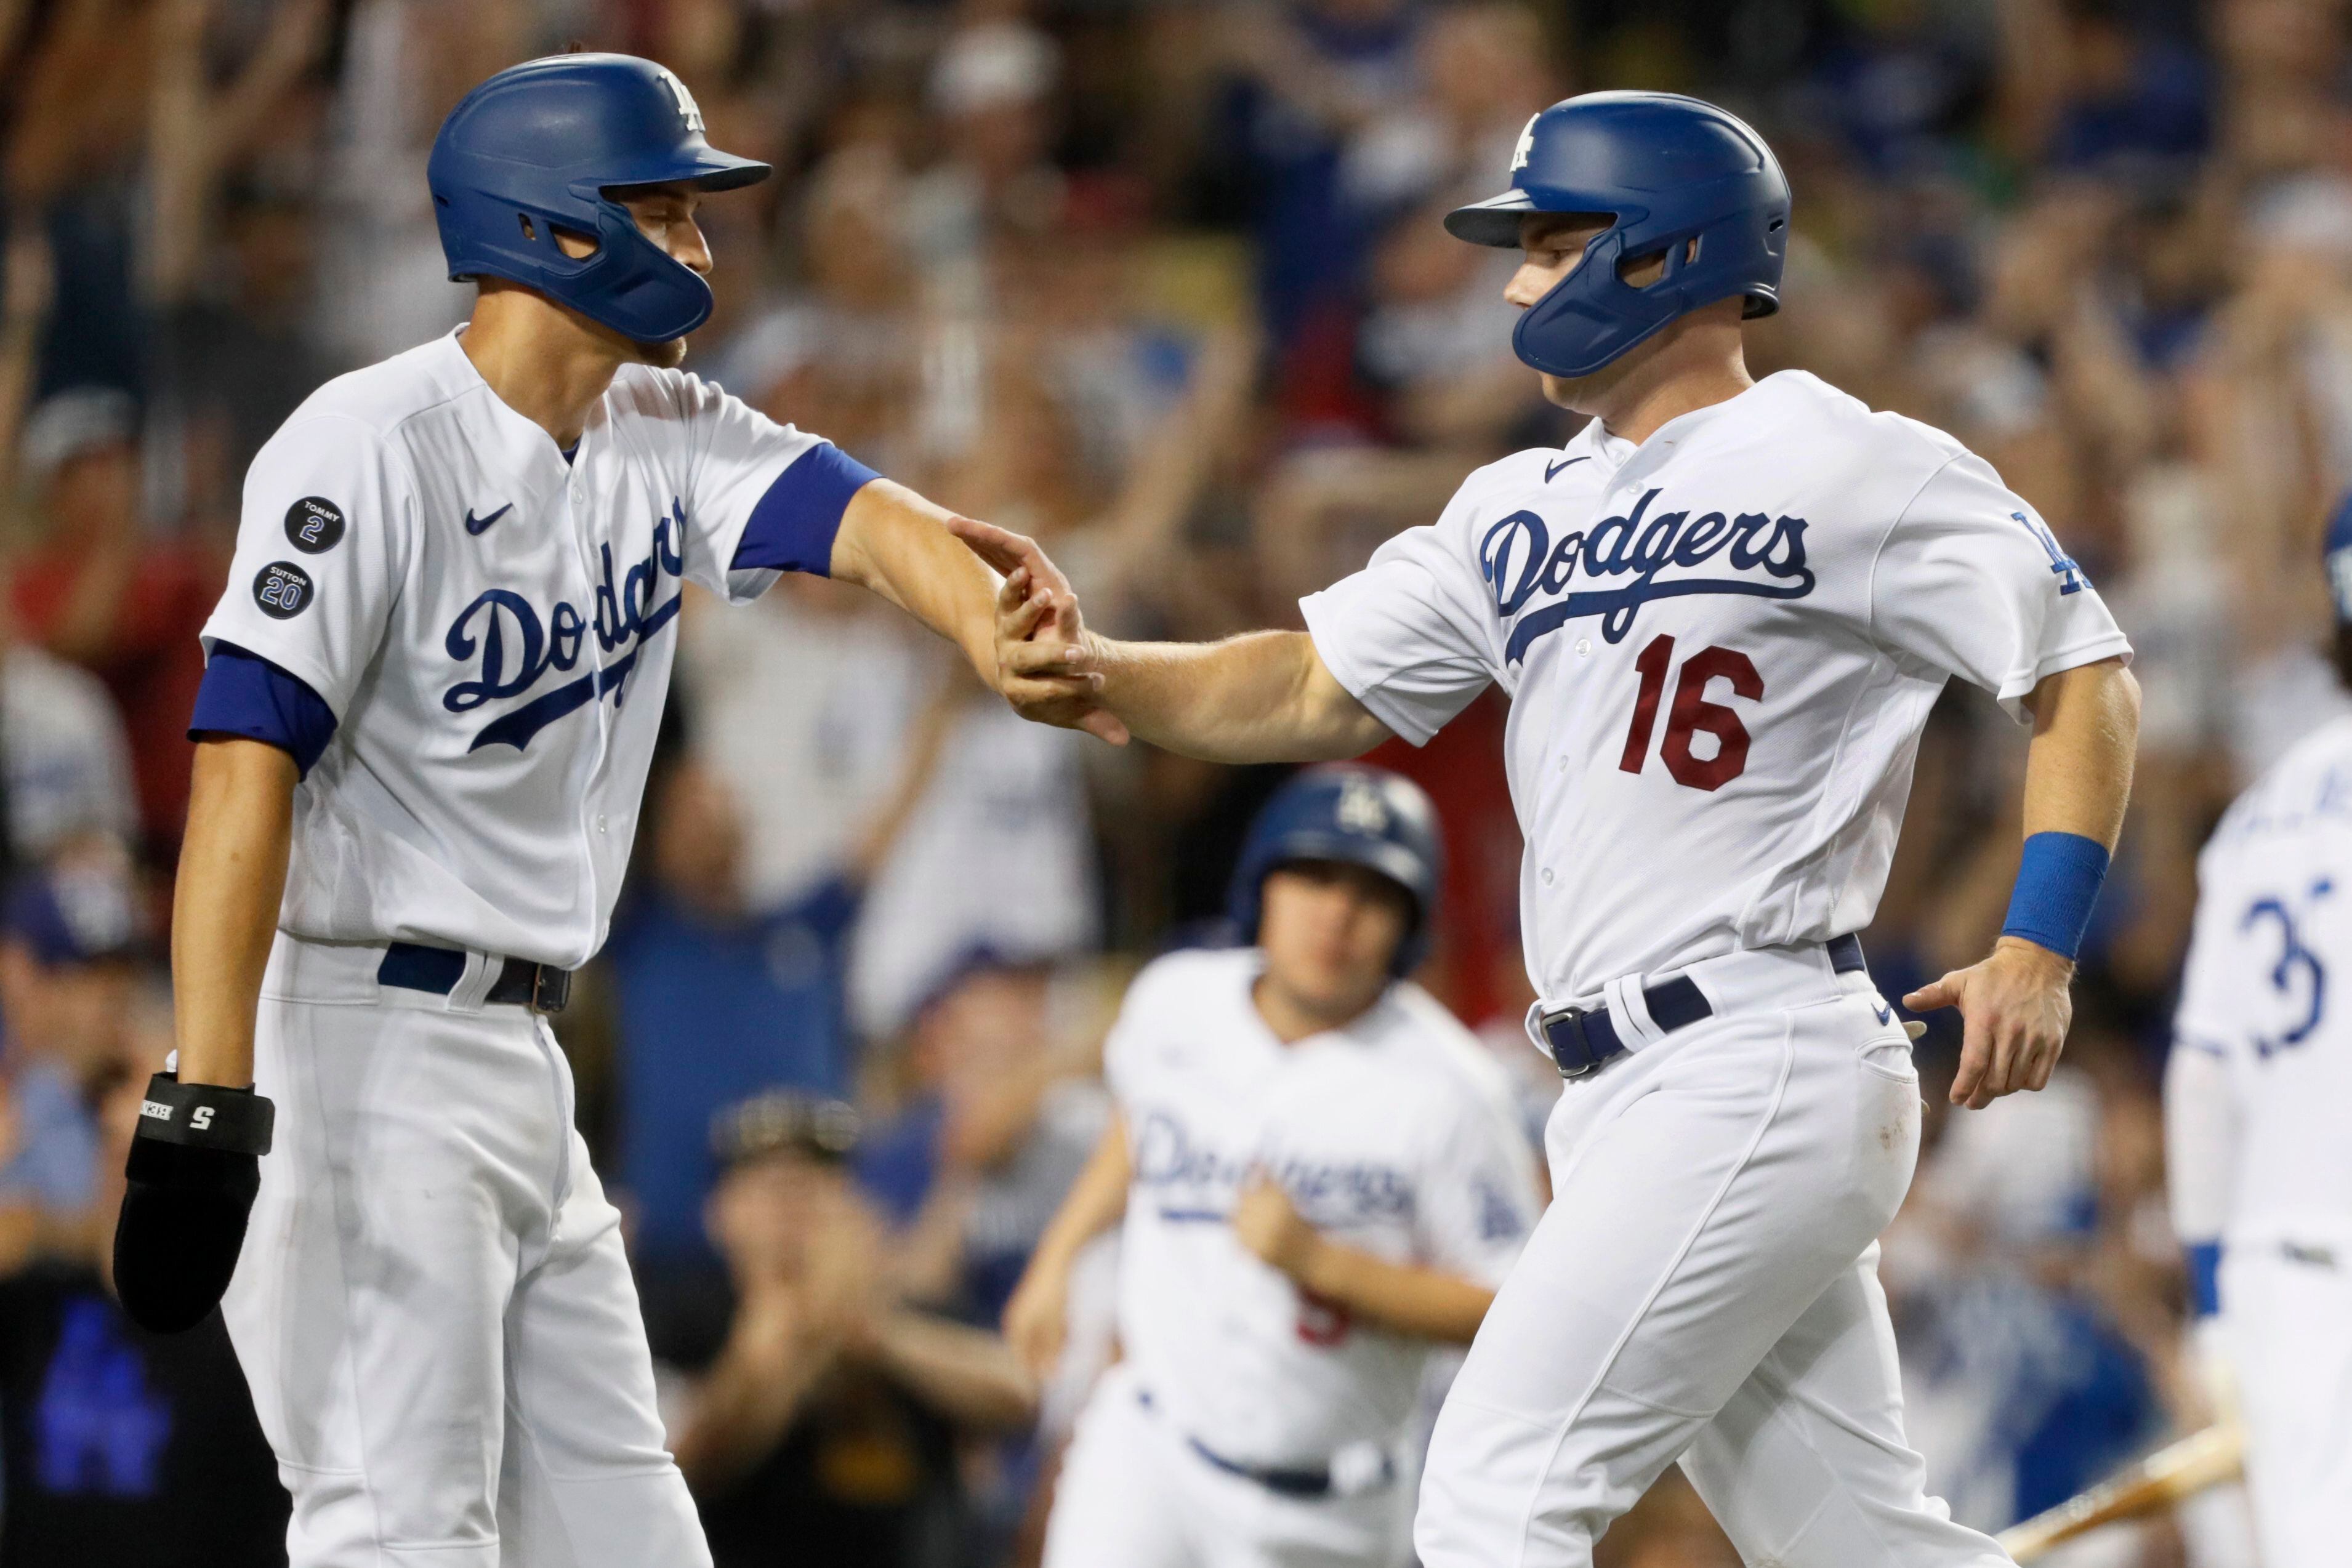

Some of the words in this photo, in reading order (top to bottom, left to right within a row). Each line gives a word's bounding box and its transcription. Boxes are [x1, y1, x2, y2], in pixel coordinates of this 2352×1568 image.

[305, 501, 340, 522] TOMMY
[299, 515, 325, 544] 2
[269, 566, 307, 586] SUTTON
[1480, 489, 1815, 646] Dodgers
[260, 576, 302, 611] 20
[1619, 633, 1765, 792] 16
